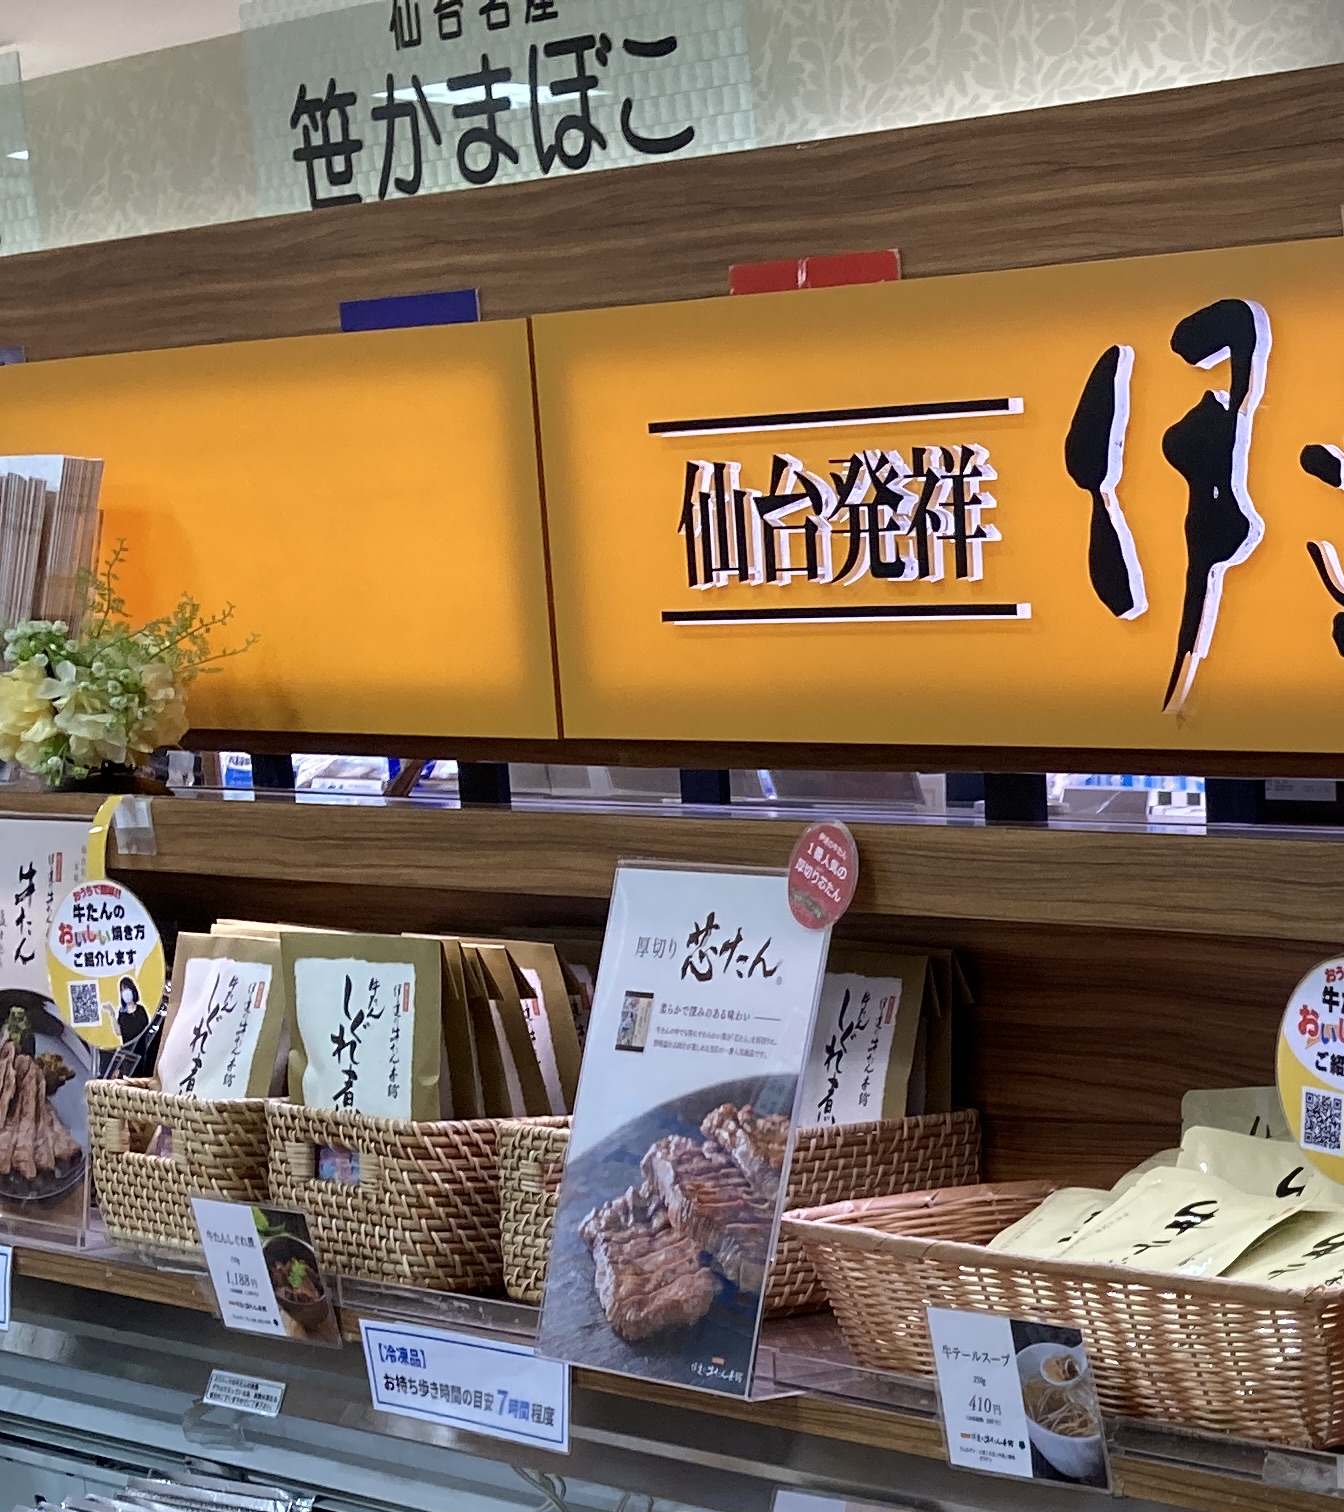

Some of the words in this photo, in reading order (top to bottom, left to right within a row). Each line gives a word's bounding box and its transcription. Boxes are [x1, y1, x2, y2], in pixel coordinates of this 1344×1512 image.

[290, 33, 696, 209] 笹かまぼこ
[677, 443, 1001, 592] 仙台発祥
[14, 860, 38, 965] 牛たん
[72, 901, 125, 924] 牛たんの
[58, 921, 146, 949] おいしい焼き方
[635, 935, 678, 960] 厚切り
[680, 910, 779, 983] 芯たん
[73, 948, 138, 968] ご紹介します
[377, 1341, 427, 1371] 【冷凍品】
[941, 1344, 1011, 1368] 牛テールスープ
[968, 1394, 1003, 1416] 410円
